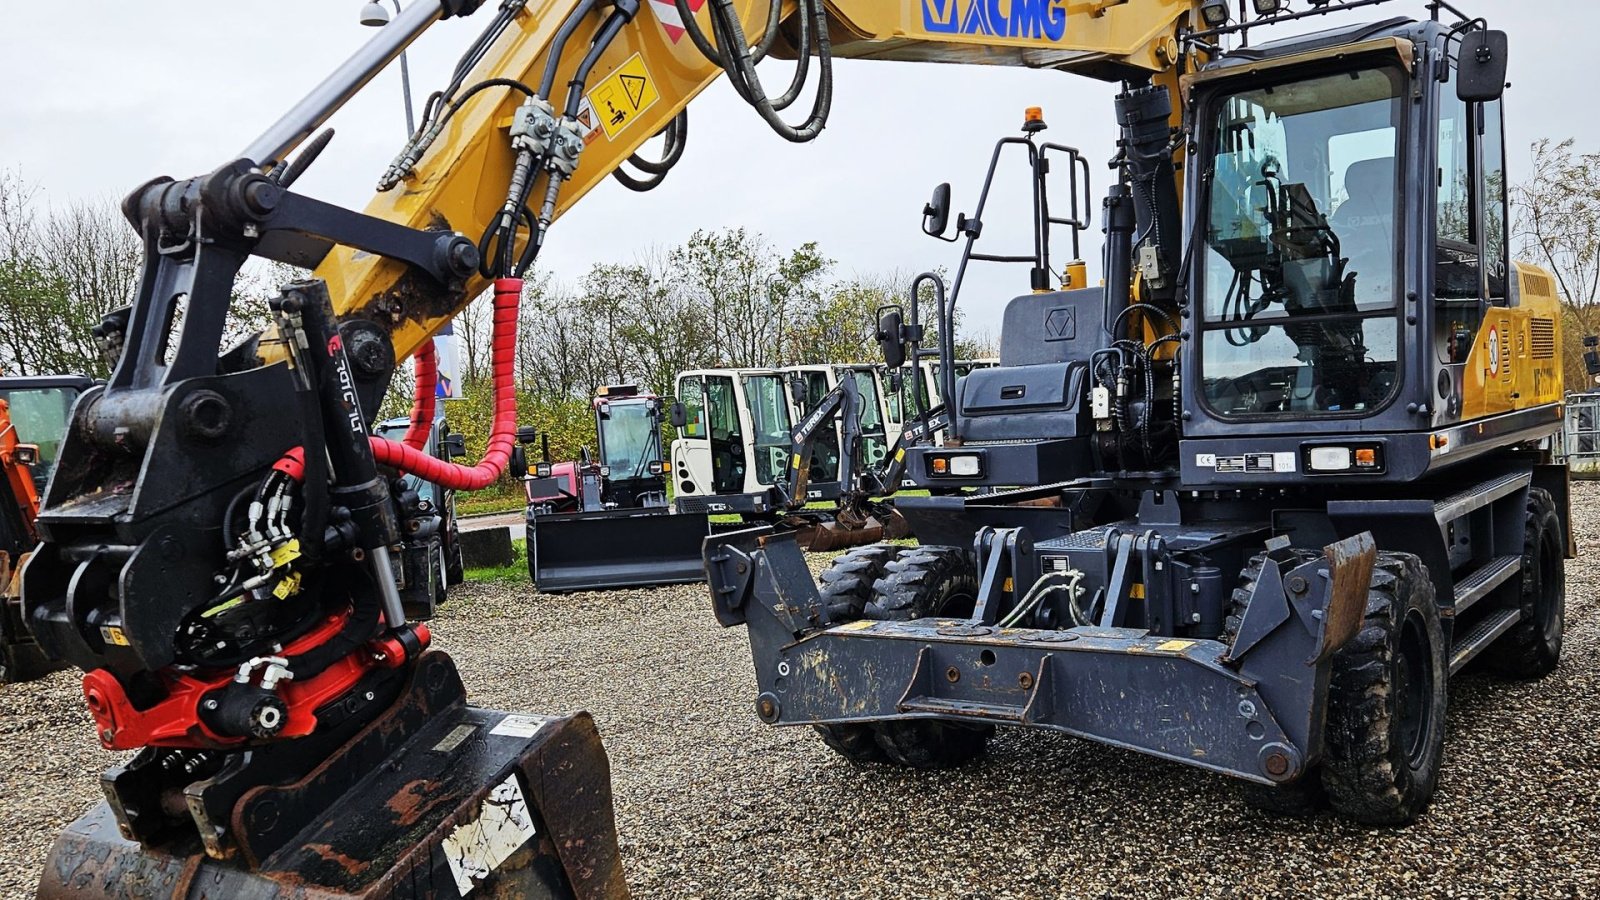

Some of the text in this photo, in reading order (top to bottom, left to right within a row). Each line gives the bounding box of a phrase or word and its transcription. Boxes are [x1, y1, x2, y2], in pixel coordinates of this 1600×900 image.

[960, 0, 1066, 41] XCMG
[801, 407, 825, 435] TEREX
[913, 416, 941, 436] TEEX
